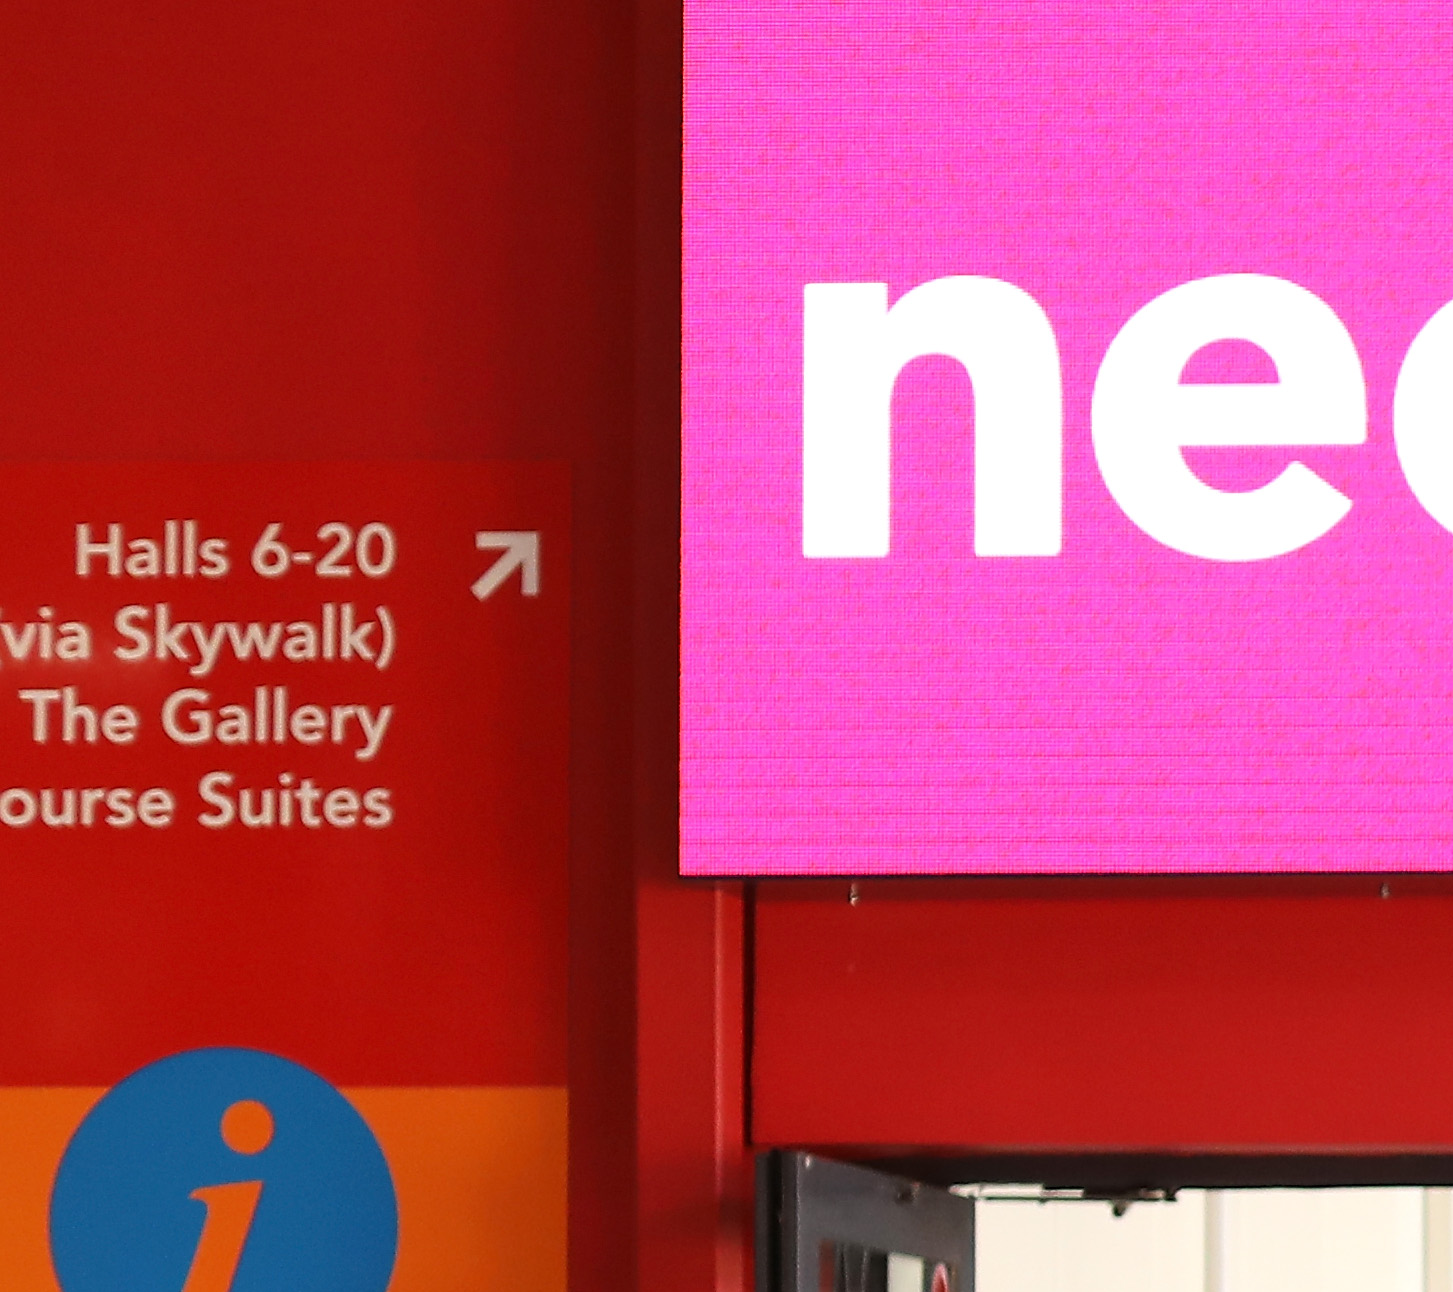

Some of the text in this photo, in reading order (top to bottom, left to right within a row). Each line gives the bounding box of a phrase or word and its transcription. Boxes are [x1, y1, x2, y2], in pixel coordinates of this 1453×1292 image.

[75, 519, 396, 578] Halls 6-20
[0, 602, 395, 676] via Skywalk)
[18, 685, 393, 760] The Gallery
[198, 770, 393, 828] Suites
